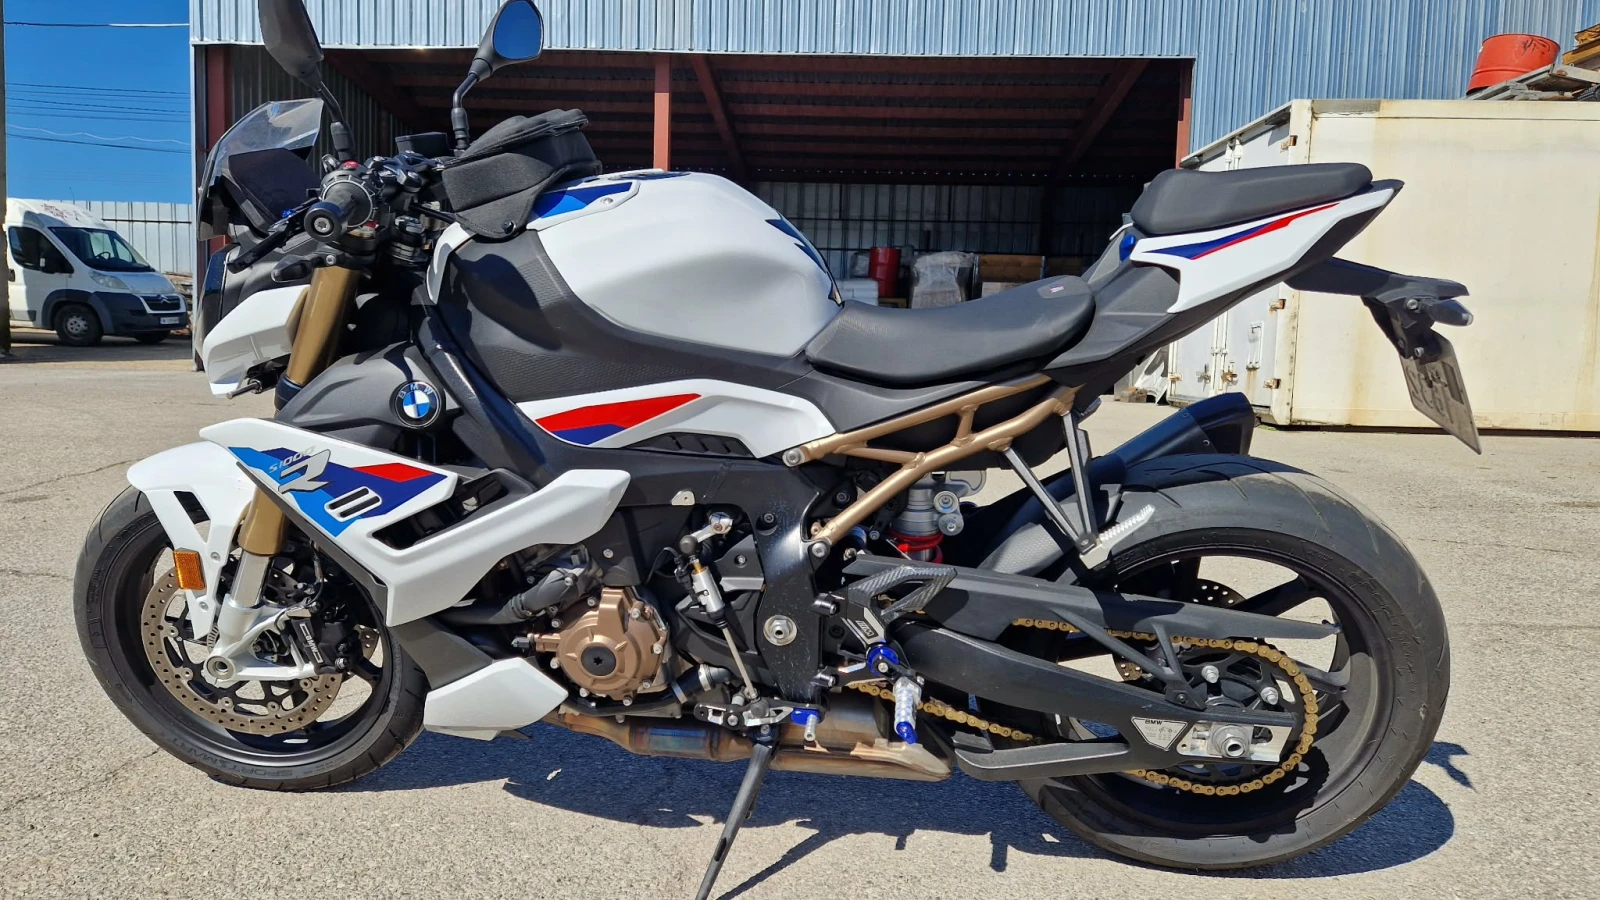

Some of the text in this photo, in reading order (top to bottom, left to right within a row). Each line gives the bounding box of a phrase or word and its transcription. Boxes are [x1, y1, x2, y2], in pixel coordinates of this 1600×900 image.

[398, 383, 433, 399] BMW
[269, 445, 316, 473] S1000
[278, 449, 331, 494] R
[305, 636, 318, 652] BMW
